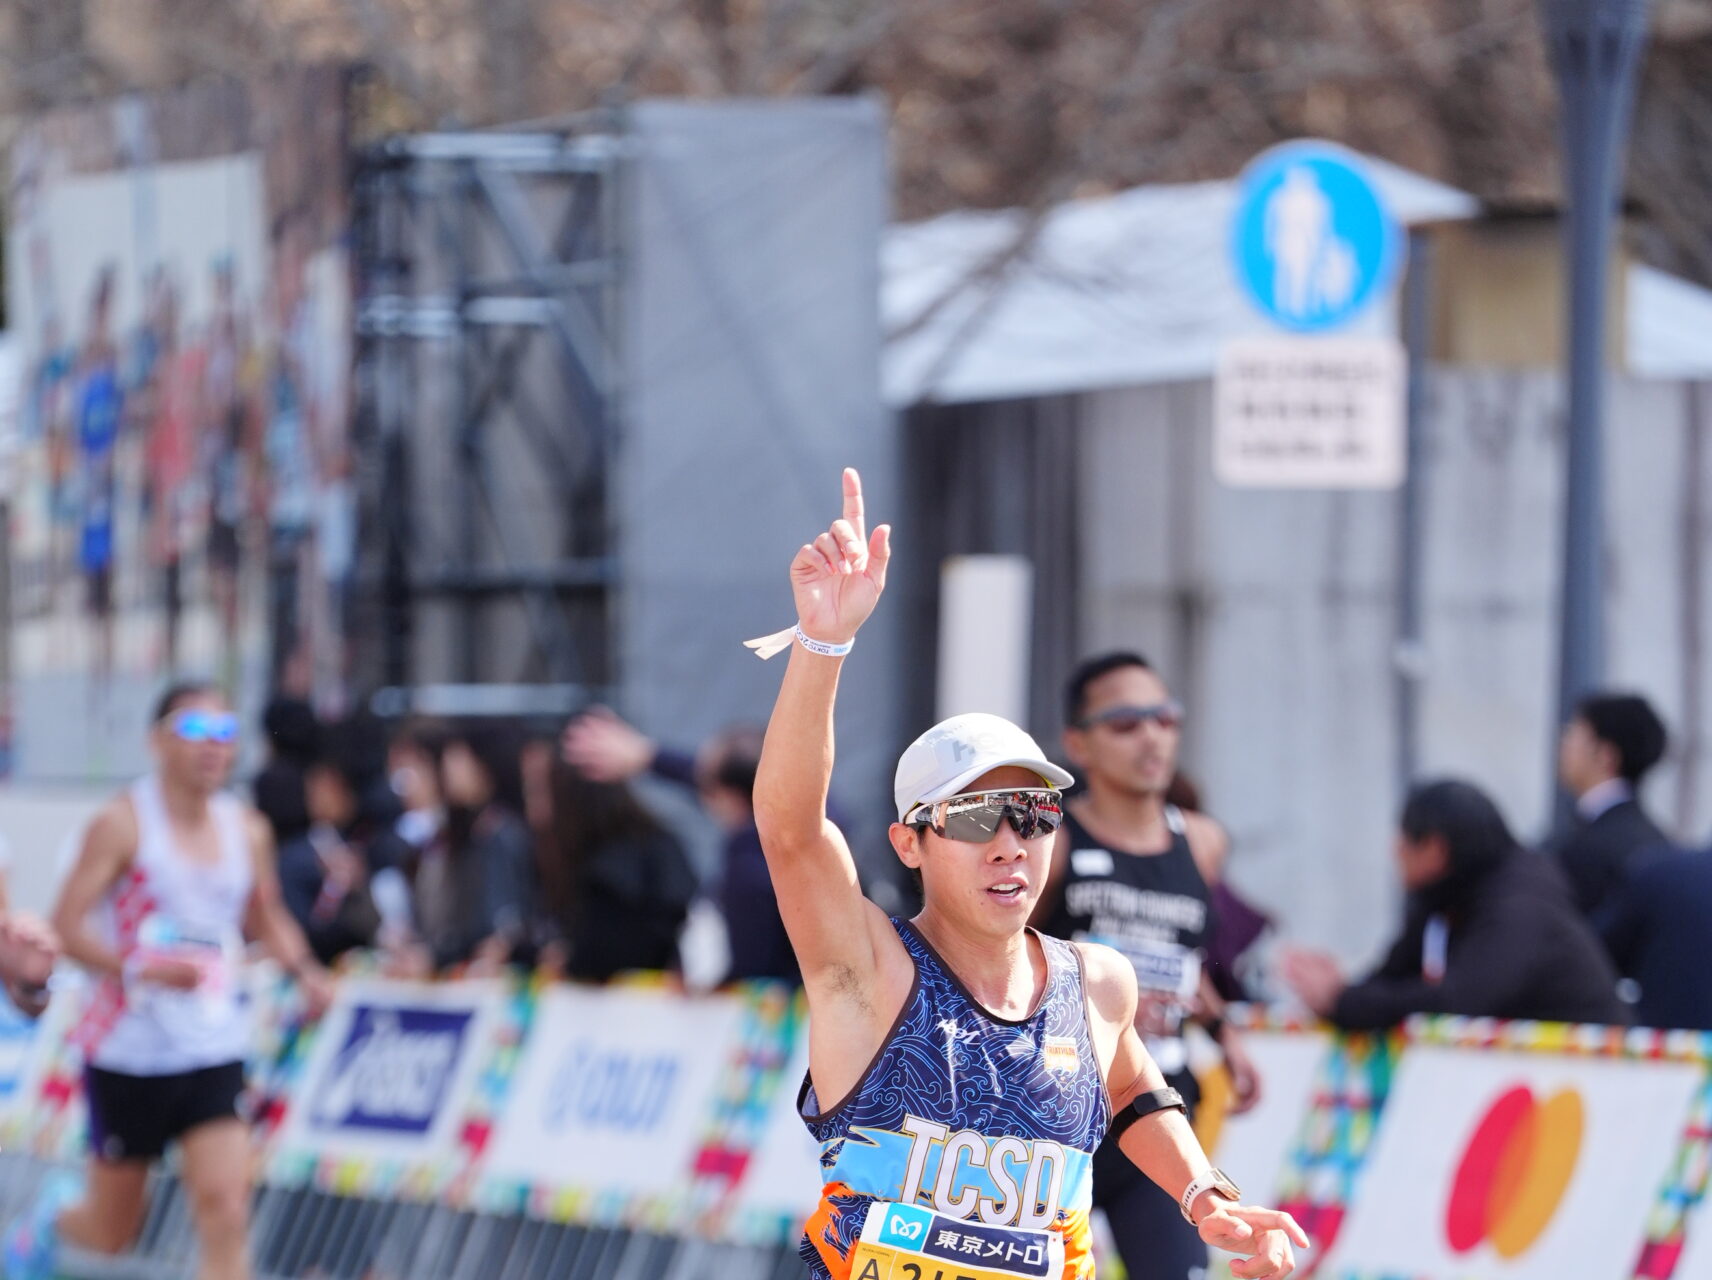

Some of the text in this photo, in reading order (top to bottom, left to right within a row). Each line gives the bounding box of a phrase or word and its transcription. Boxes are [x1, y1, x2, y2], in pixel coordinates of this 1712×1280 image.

[901, 1113, 1066, 1229] TCSD
[934, 1229, 1044, 1266] 東京メトロ
